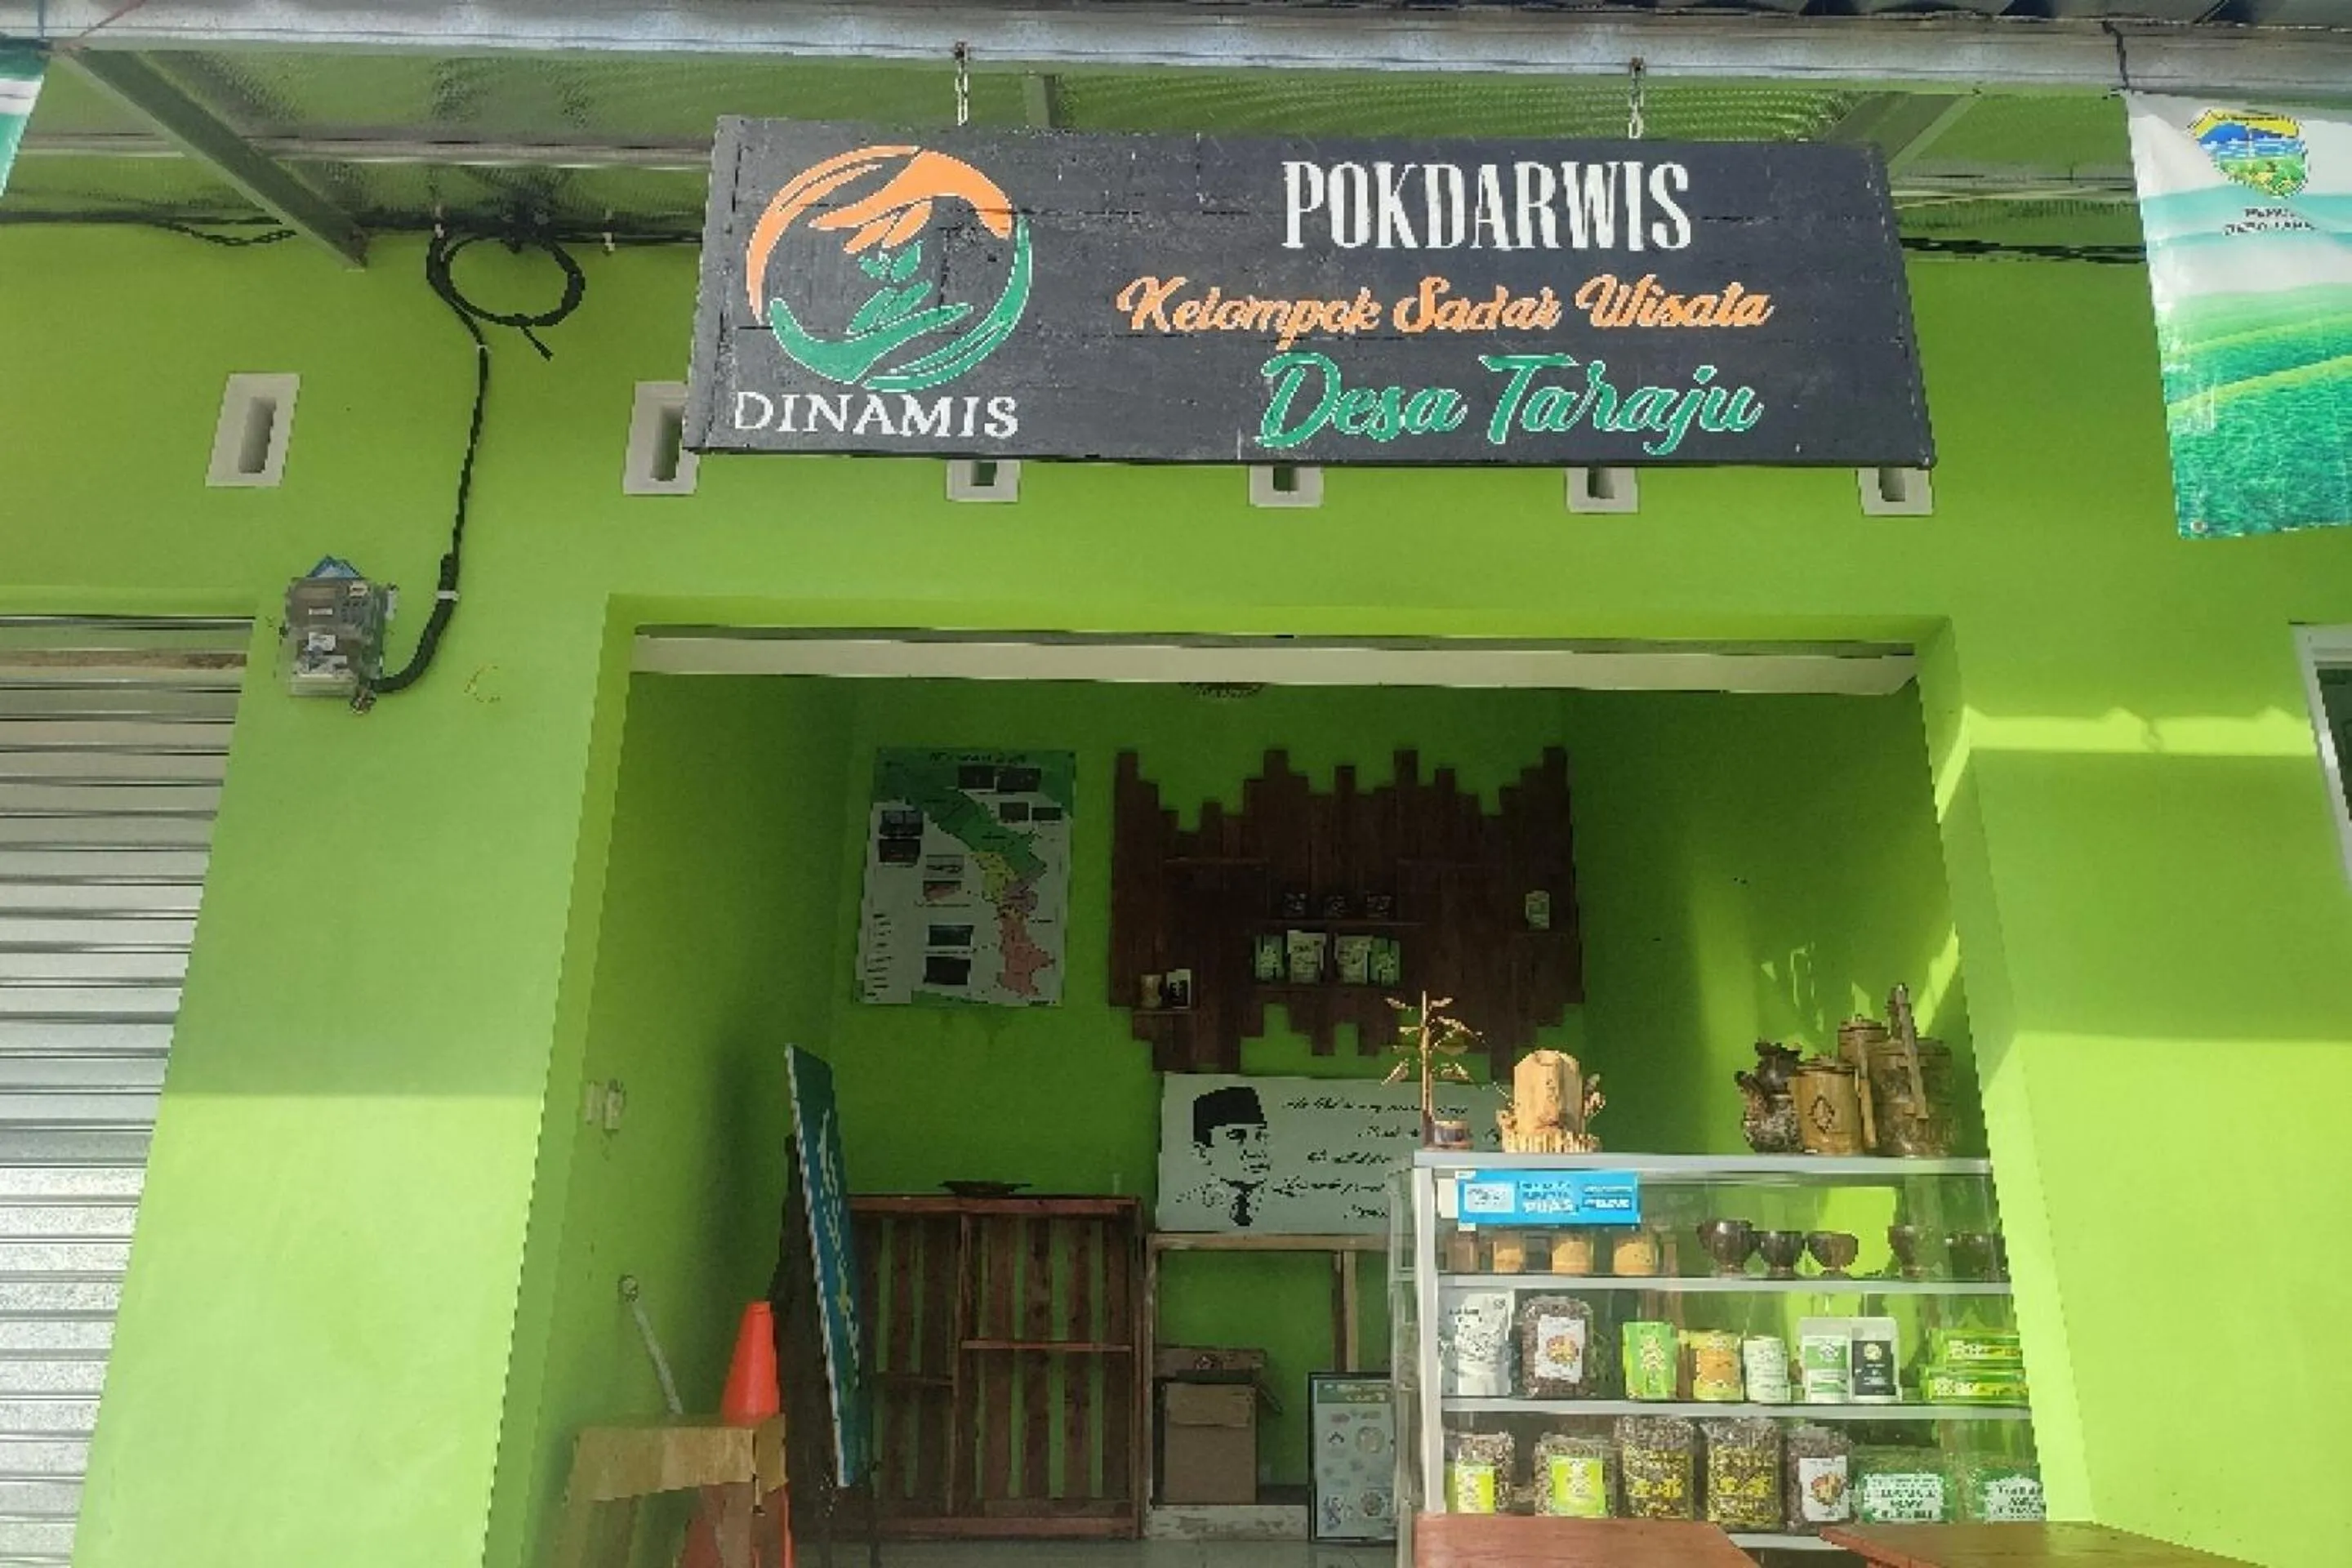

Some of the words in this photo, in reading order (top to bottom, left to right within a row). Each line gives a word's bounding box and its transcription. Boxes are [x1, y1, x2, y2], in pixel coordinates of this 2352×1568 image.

[1281, 161, 1692, 252] POKDARWIS
[1116, 274, 1383, 351] Kelompok
[1392, 274, 1562, 333] Sadar
[1575, 273, 1776, 327] Wisata
[734, 391, 1019, 439] DINAMIS
[1253, 351, 1468, 448] Desa
[1477, 352, 1766, 457] Taraju
